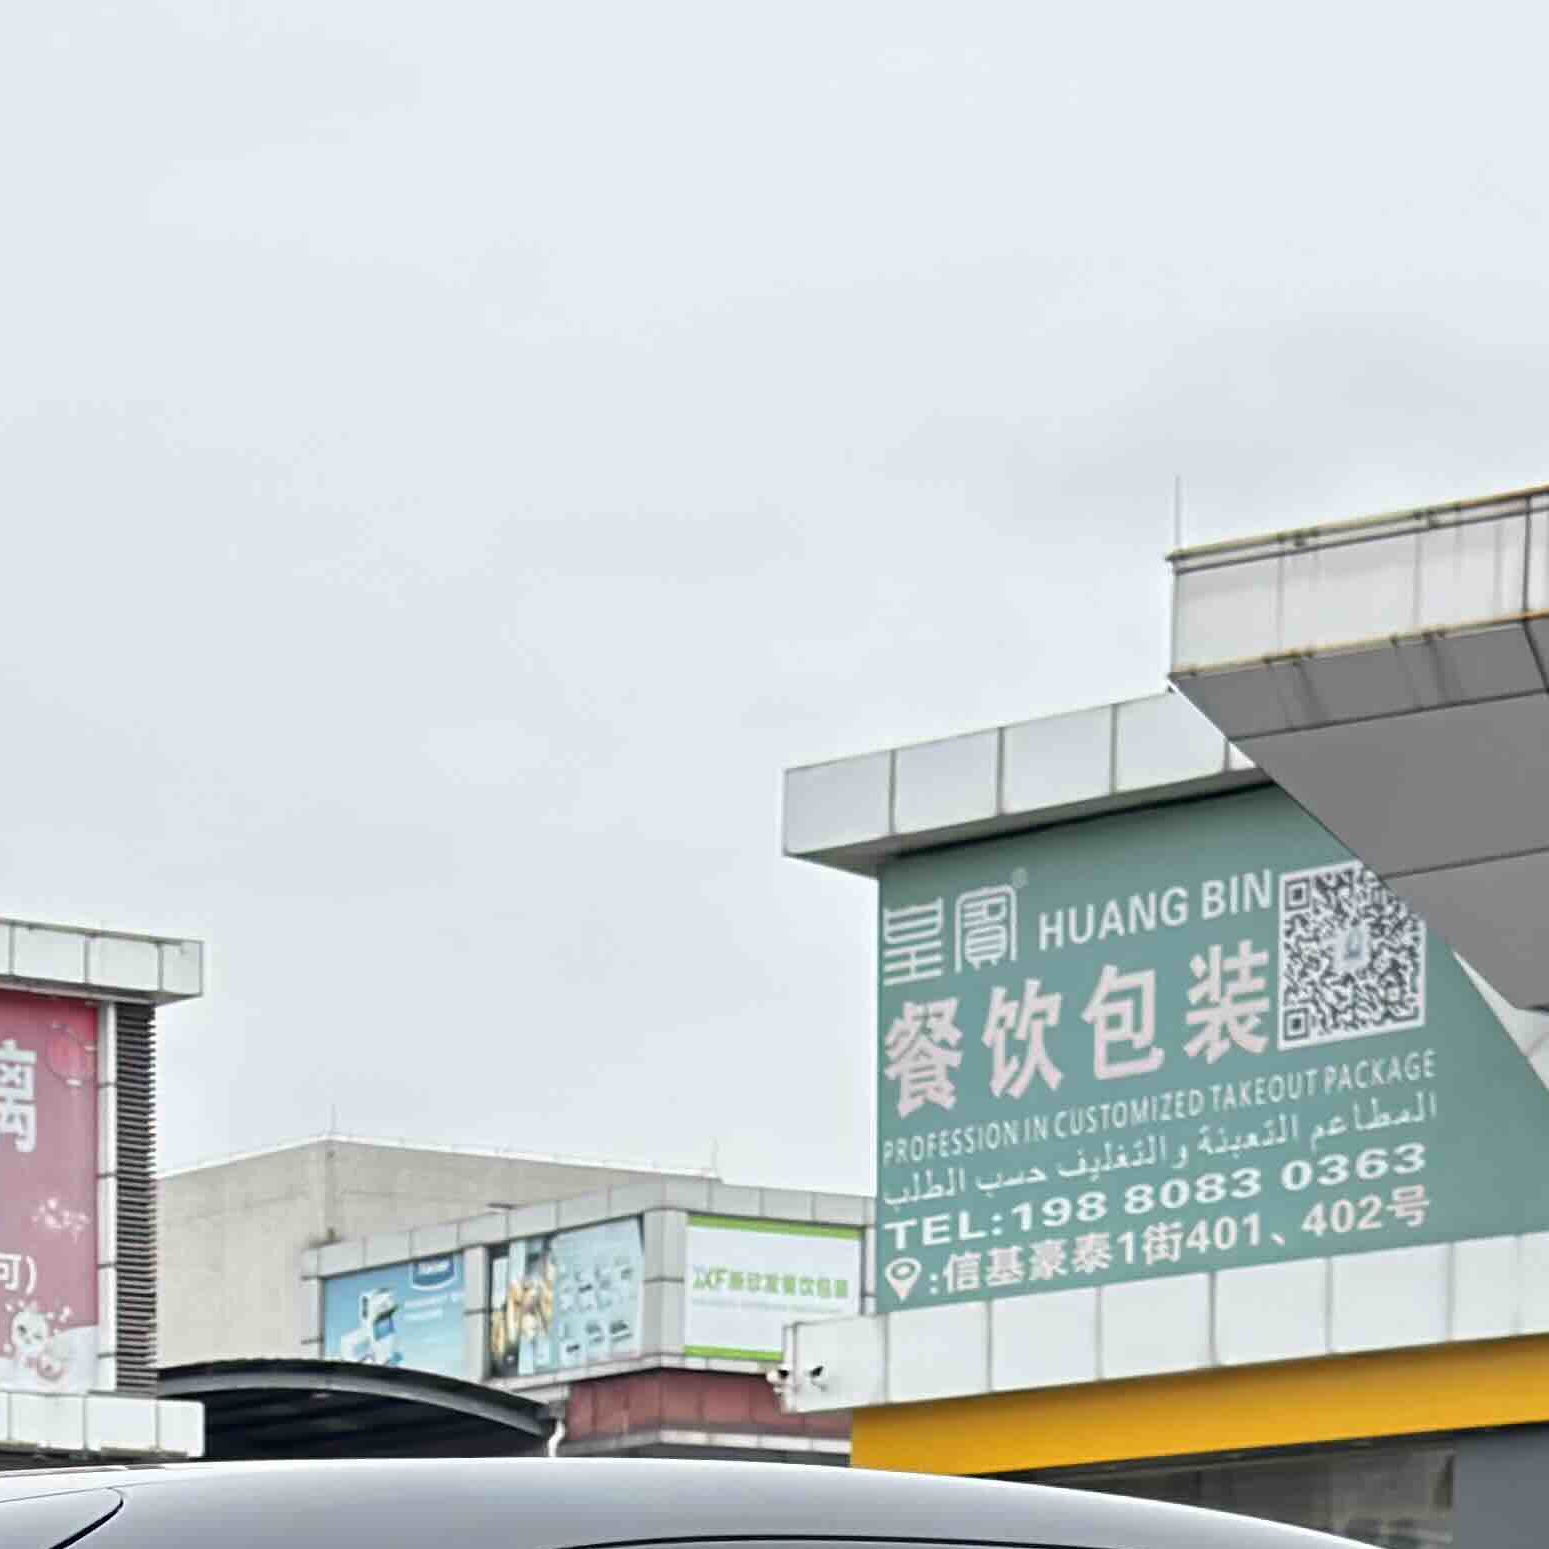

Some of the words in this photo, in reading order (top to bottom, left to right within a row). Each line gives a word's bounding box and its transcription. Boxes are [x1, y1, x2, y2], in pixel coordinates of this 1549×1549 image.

[1038, 887, 1190, 951] HUANG
[1200, 869, 1272, 922] BIN
[883, 940, 1271, 1118] 餐饮包装
[883, 1126, 1020, 1167] PROFESSION
[1023, 1118, 1050, 1144] IN
[1054, 1088, 1204, 1140] CUSTOMIZED
[1209, 1069, 1320, 1113] TAKEOUT
[1324, 1049, 1437, 1094] PACKAGE
[1124, 1167, 1263, 1216] 8083
[1281, 1142, 1428, 1193] 0363
